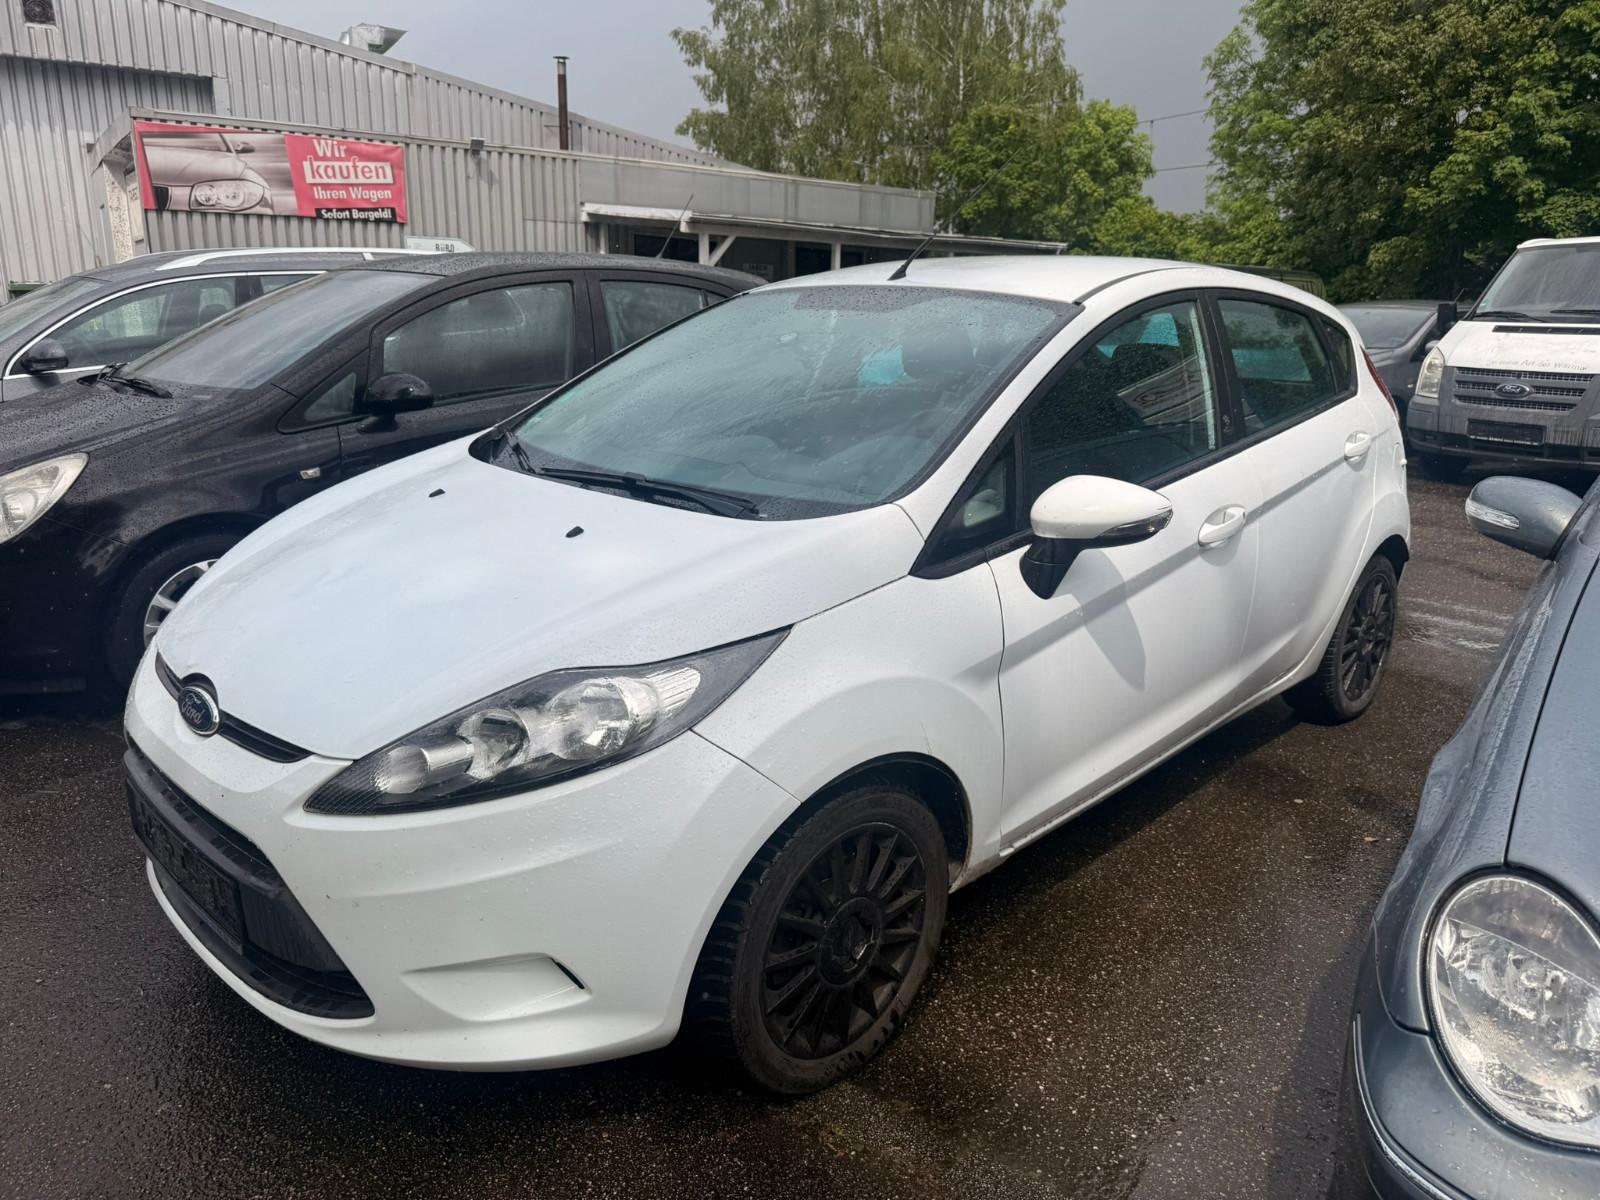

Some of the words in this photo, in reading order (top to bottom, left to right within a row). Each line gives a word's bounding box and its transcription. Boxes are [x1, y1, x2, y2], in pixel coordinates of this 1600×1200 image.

[313, 139, 347, 157] Wir
[308, 156, 387, 179] kaufen
[313, 186, 347, 199] Ihren
[349, 186, 392, 202] Wagen
[320, 208, 350, 219] Sofort
[351, 208, 392, 221] Bargeld!
[1503, 385, 1521, 393] Ford
[182, 693, 205, 724] Ford
